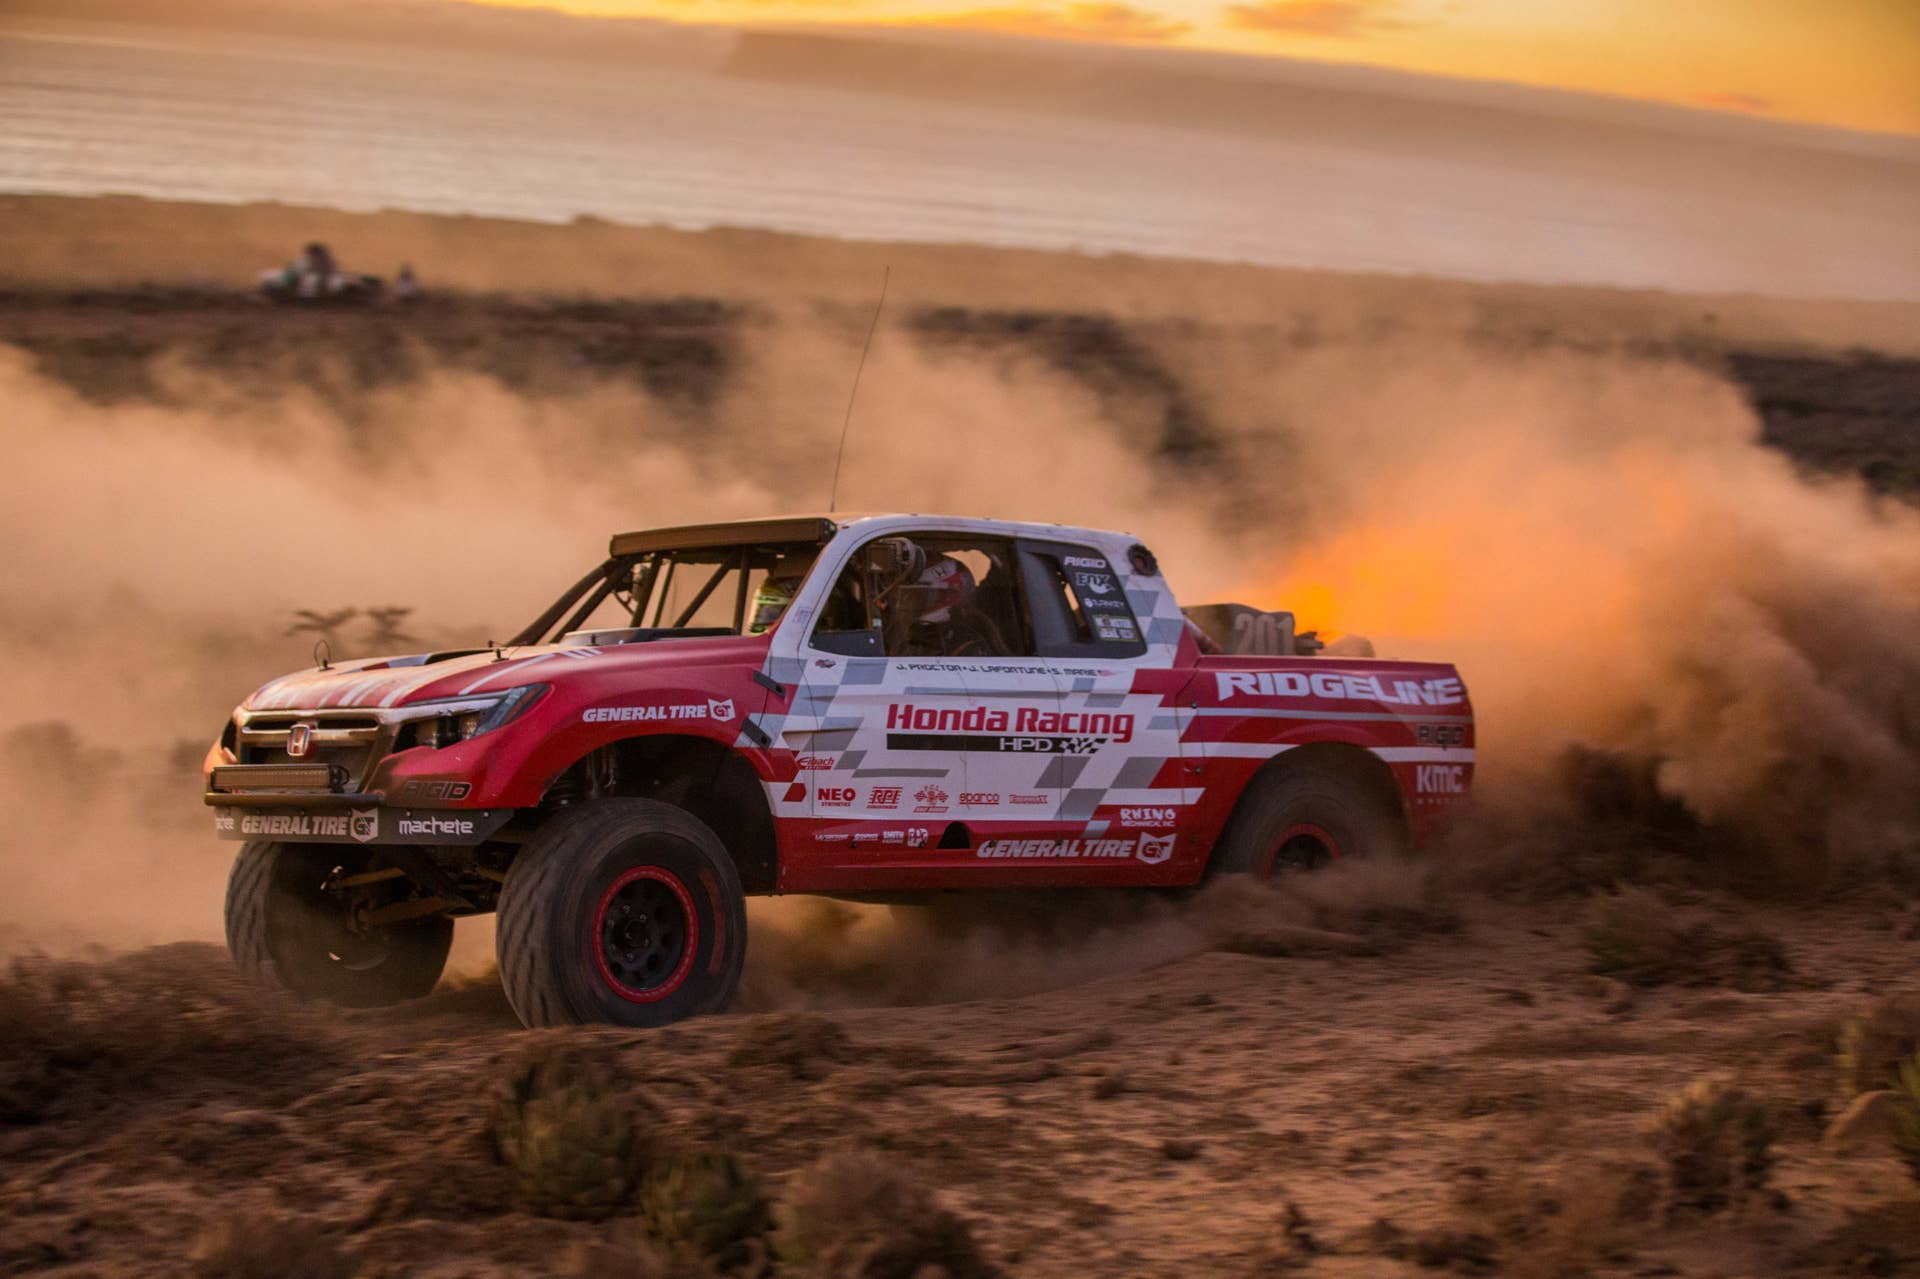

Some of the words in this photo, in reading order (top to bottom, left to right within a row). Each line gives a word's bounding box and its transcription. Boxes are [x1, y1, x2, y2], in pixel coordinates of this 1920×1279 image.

[1064, 556, 1106, 568] RIGID
[1215, 672, 1462, 706] RIDGELINE
[582, 706, 668, 722] GENERAL
[669, 704, 707, 719] TIRE
[886, 703, 1009, 732] Honda
[1015, 708, 1135, 743] Racing
[999, 737, 1053, 752] HPD
[818, 788, 856, 802] NEO
[959, 792, 1000, 803] sparco
[241, 815, 310, 835] GENERAL
[311, 815, 349, 835] TIRE
[399, 816, 474, 835] machete
[977, 840, 1081, 858] GENERAL
[1082, 839, 1137, 858] TIRE
